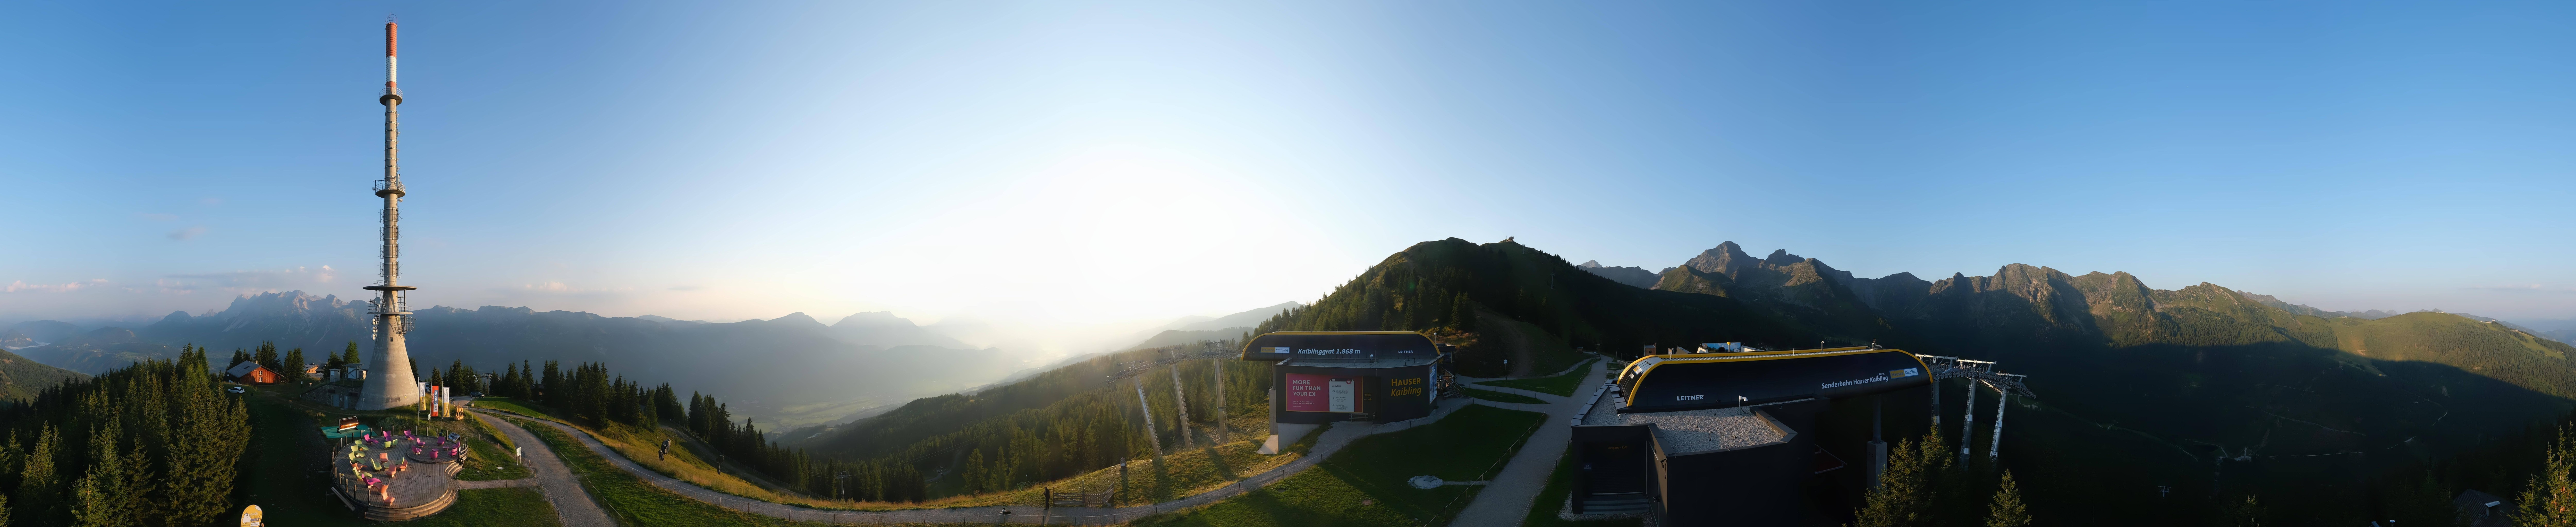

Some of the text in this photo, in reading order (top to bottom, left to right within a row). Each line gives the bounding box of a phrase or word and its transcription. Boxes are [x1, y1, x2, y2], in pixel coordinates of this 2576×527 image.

[1391, 378, 1421, 386] HAUSER
[1822, 380, 1852, 389] Senderbahn
[1391, 387, 1421, 397] Kaibling
